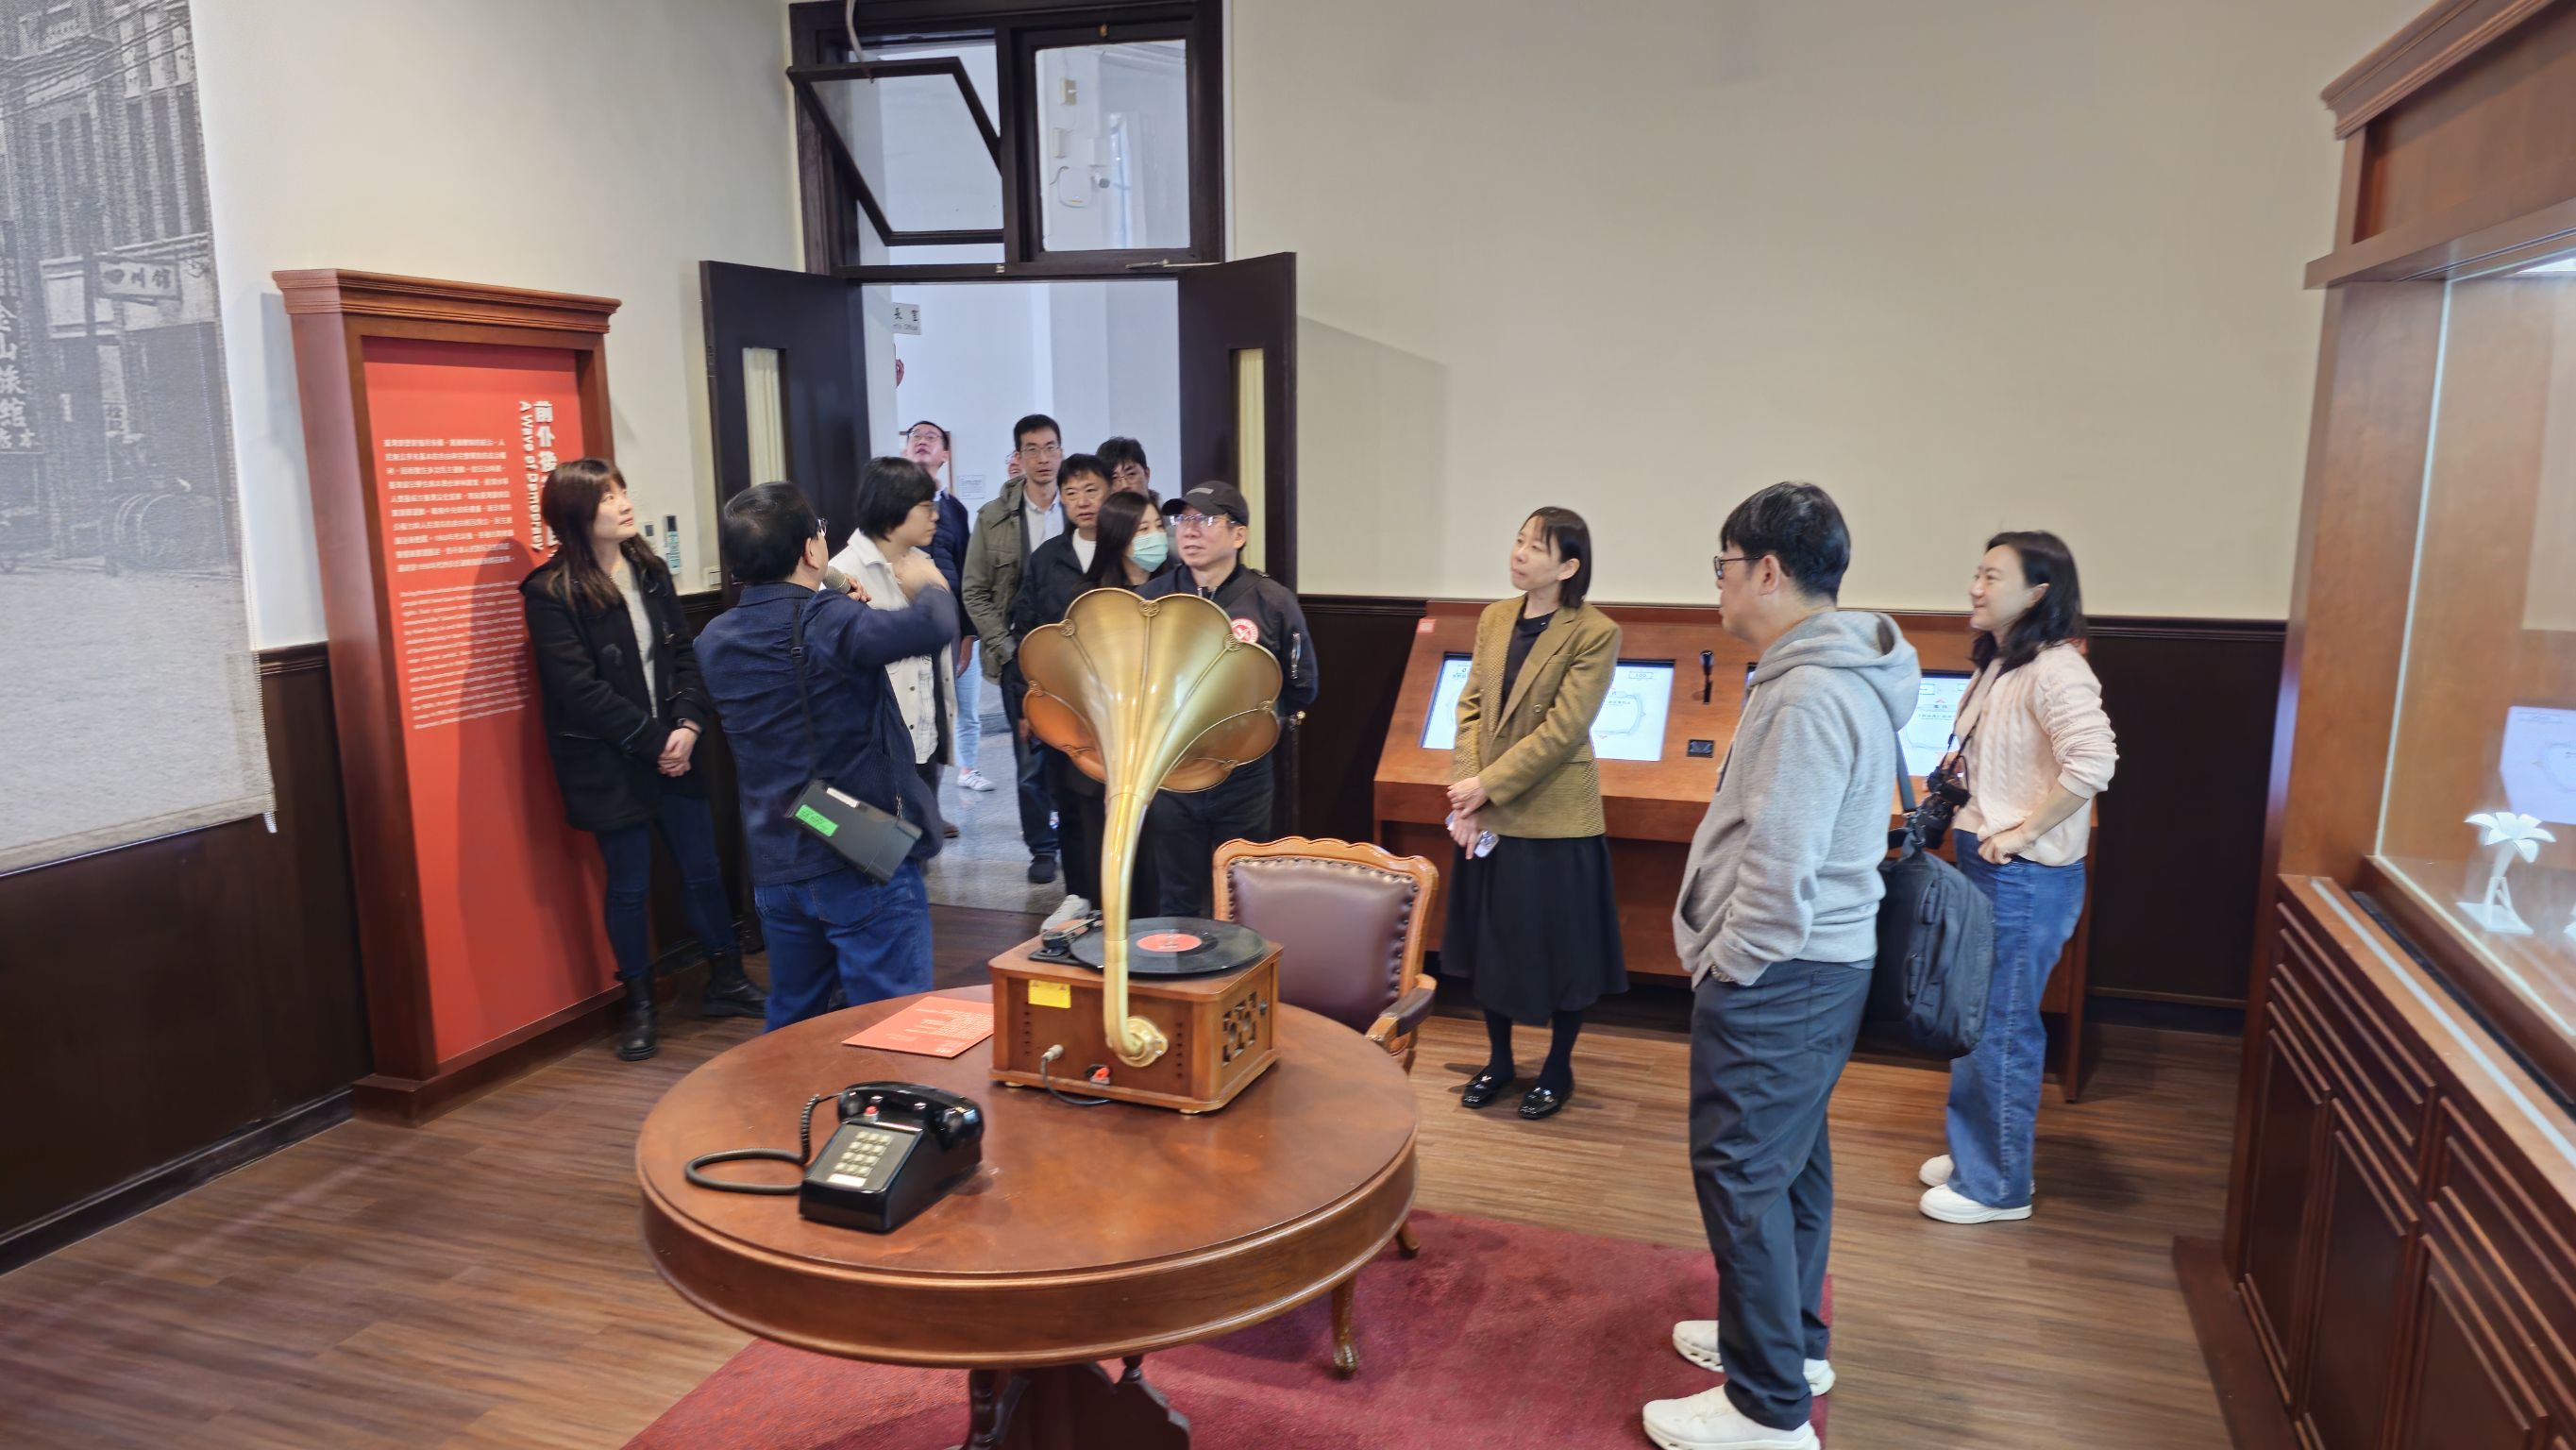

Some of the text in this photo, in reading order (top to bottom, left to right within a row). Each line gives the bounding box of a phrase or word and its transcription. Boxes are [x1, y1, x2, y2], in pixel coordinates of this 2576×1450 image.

[518, 400, 545, 550] A Wave of Democracy
